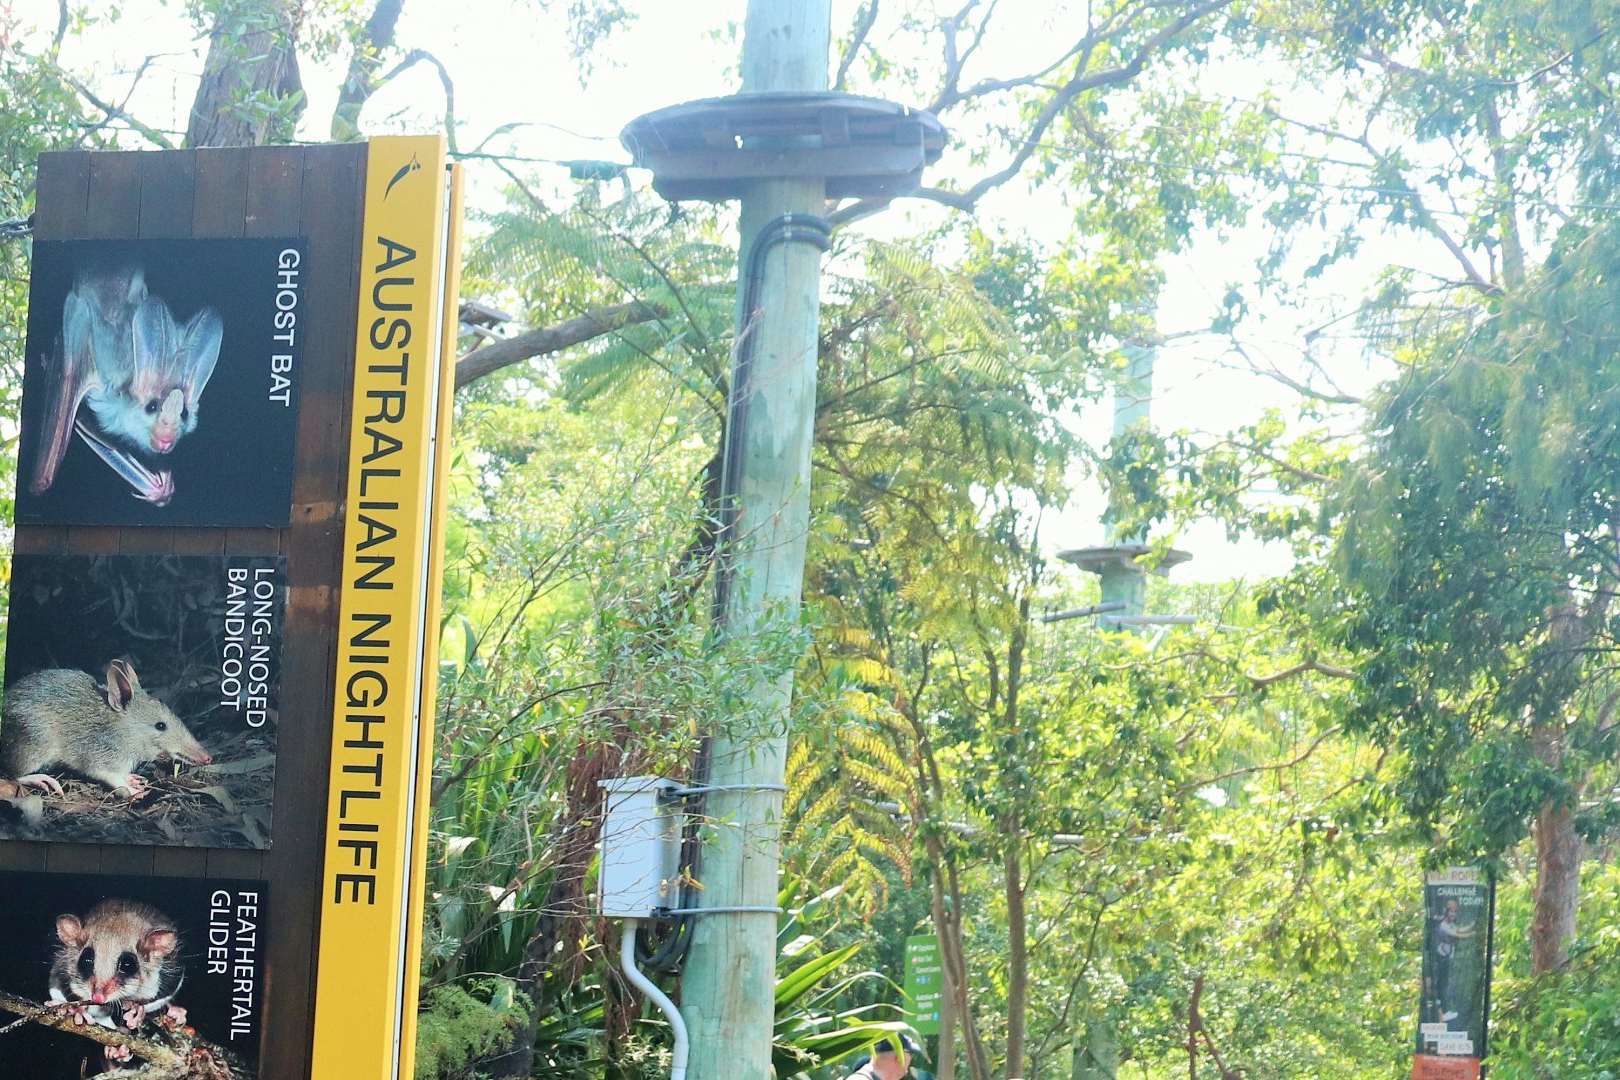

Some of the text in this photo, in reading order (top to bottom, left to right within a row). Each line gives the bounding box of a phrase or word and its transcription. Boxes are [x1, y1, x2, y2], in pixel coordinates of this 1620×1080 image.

[269, 248, 300, 407] GHOST BAT
[220, 568, 248, 711] BANDICOOT
[334, 236, 416, 905] AUSTRALIAN NIGHTLIFE
[246, 568, 275, 729] LONG-NOSED
[207, 890, 231, 975] GLIDER
[230, 891, 258, 1041] FEATHERTAIL
